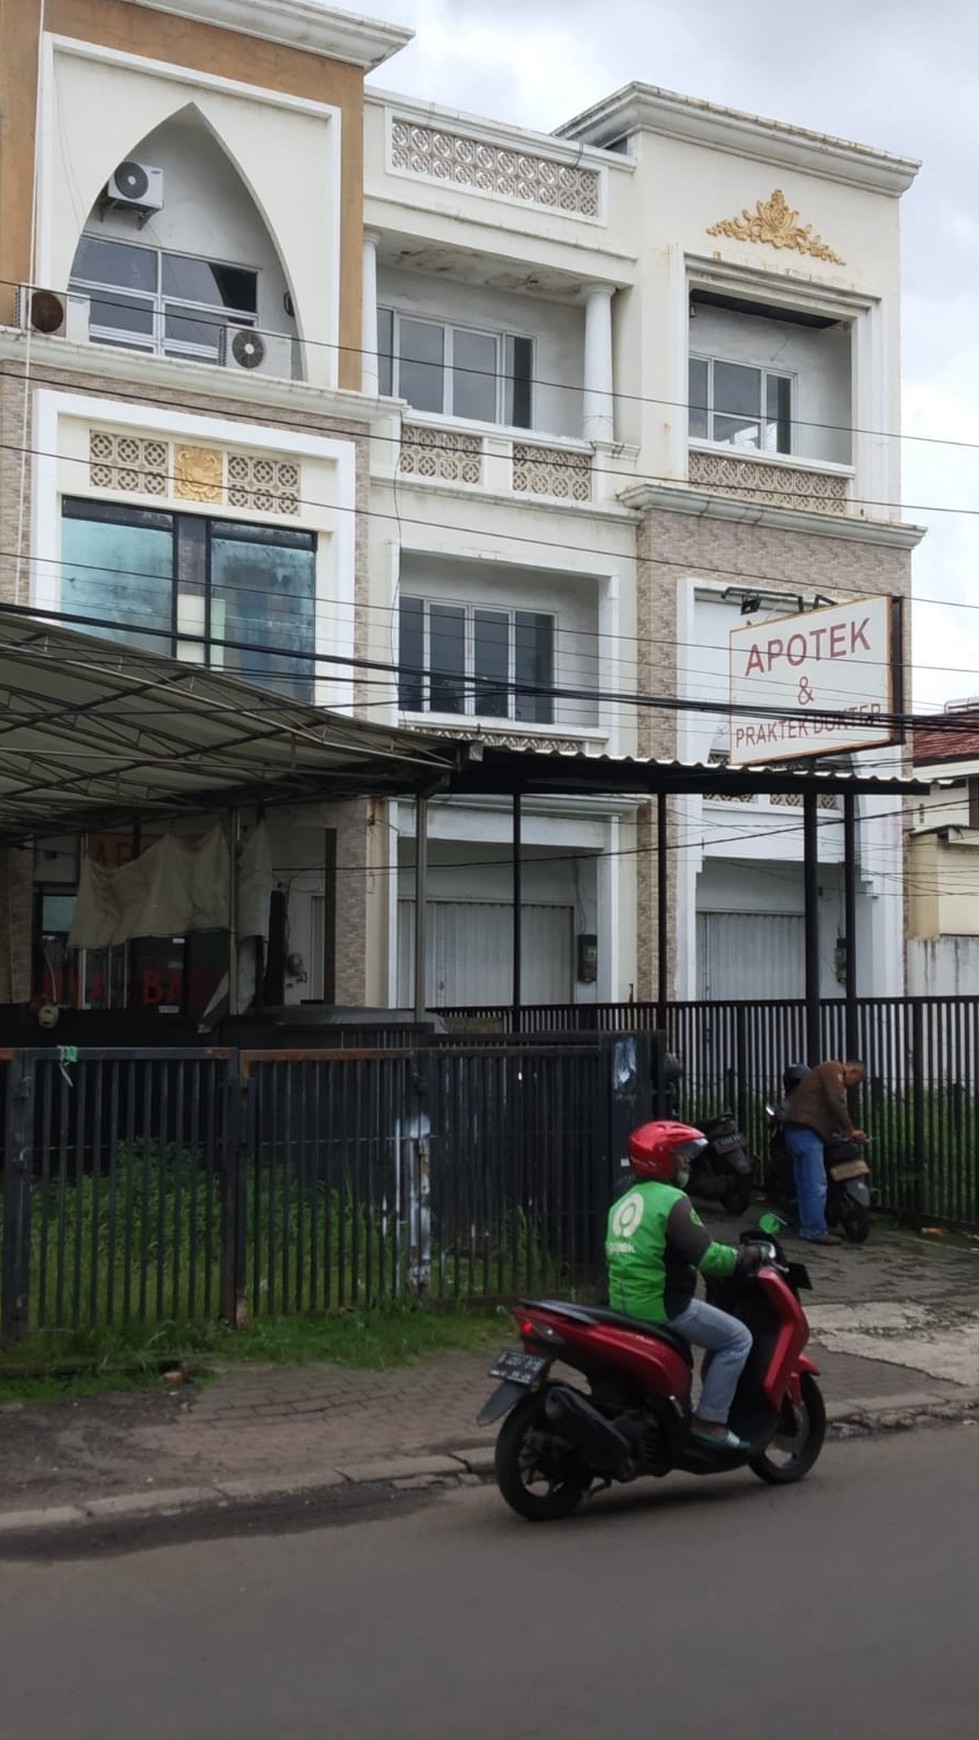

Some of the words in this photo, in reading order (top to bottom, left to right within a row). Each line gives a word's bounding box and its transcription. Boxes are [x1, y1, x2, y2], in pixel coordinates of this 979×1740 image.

[745, 617, 871, 677] APOTEK
[797, 676, 814, 706] &
[736, 716, 808, 748] PRAKTEK
